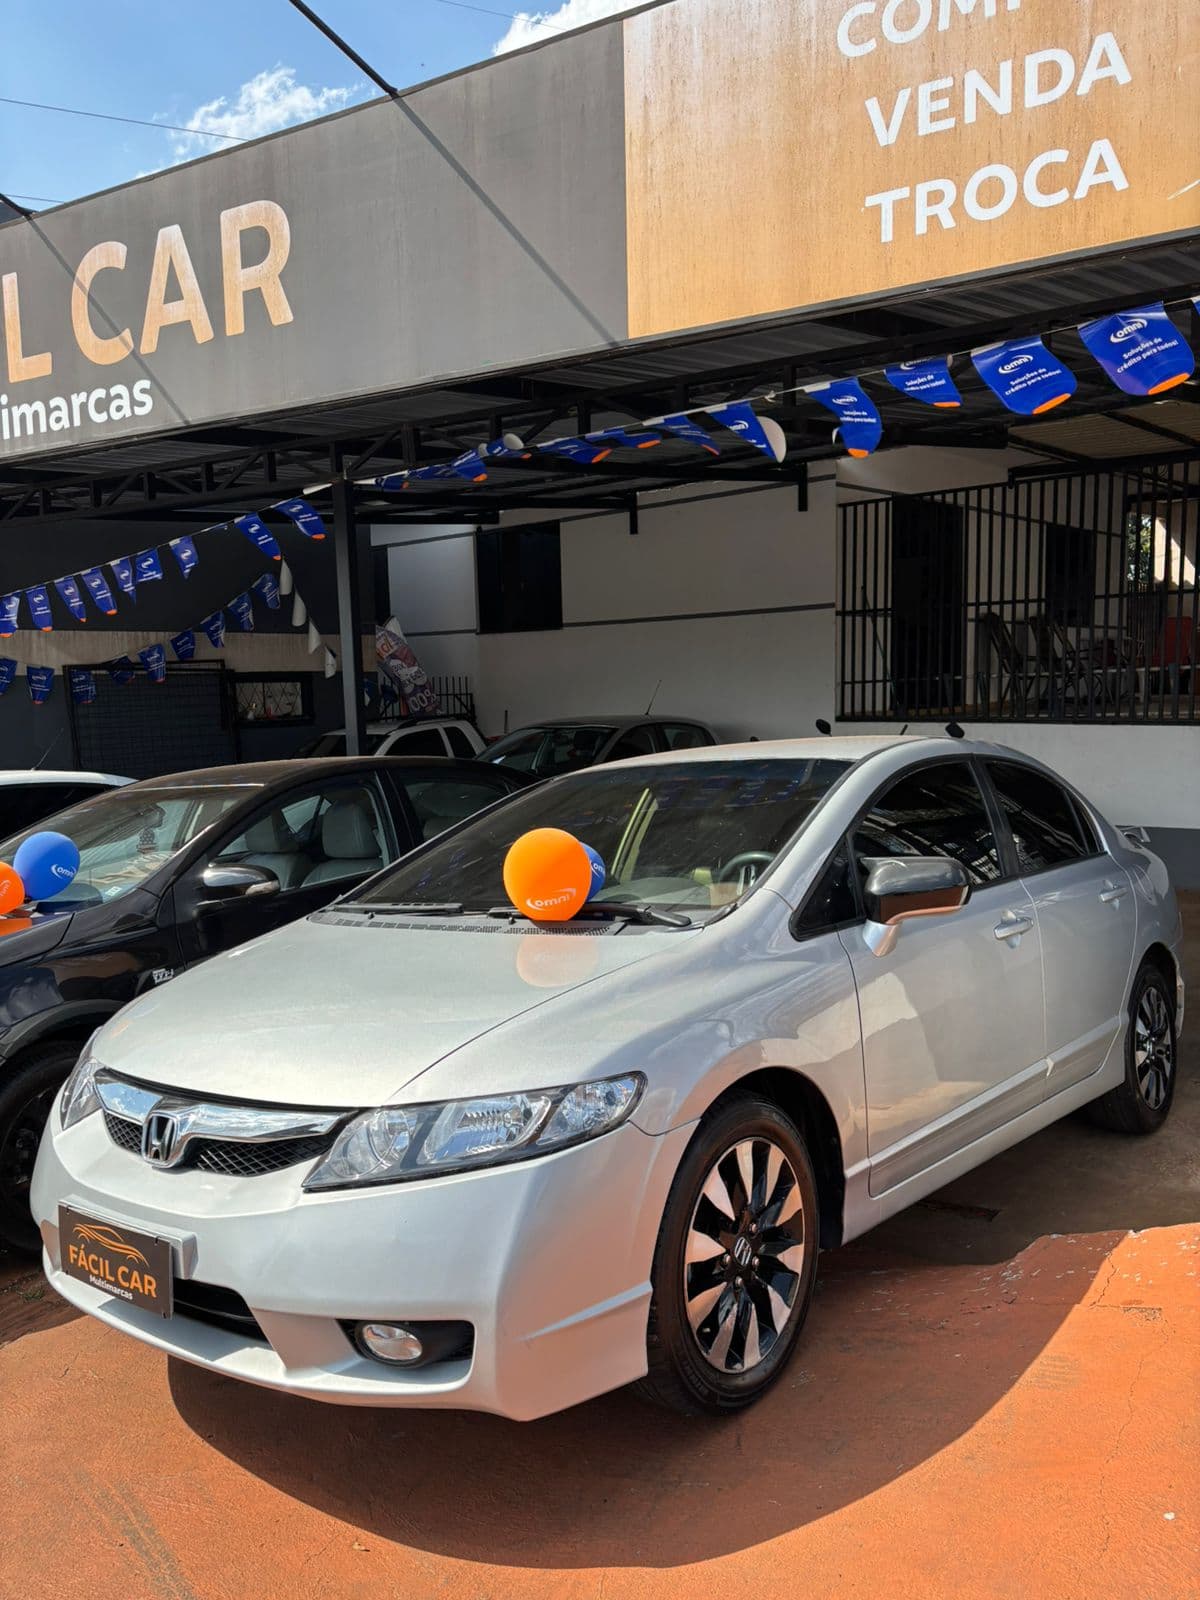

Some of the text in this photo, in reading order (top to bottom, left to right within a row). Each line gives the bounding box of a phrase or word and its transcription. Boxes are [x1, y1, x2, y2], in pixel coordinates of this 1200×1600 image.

[865, 31, 1132, 147] VENDA
[864, 138, 1129, 242] TROCA
[71, 199, 294, 366] CAR
[1115, 320, 1145, 339] omni
[1002, 355, 1031, 371] omni
[533, 892, 573, 908] omni
[69, 1243, 158, 1298] FÁCIL CAR
[89, 1274, 134, 1301] Multimarcas
